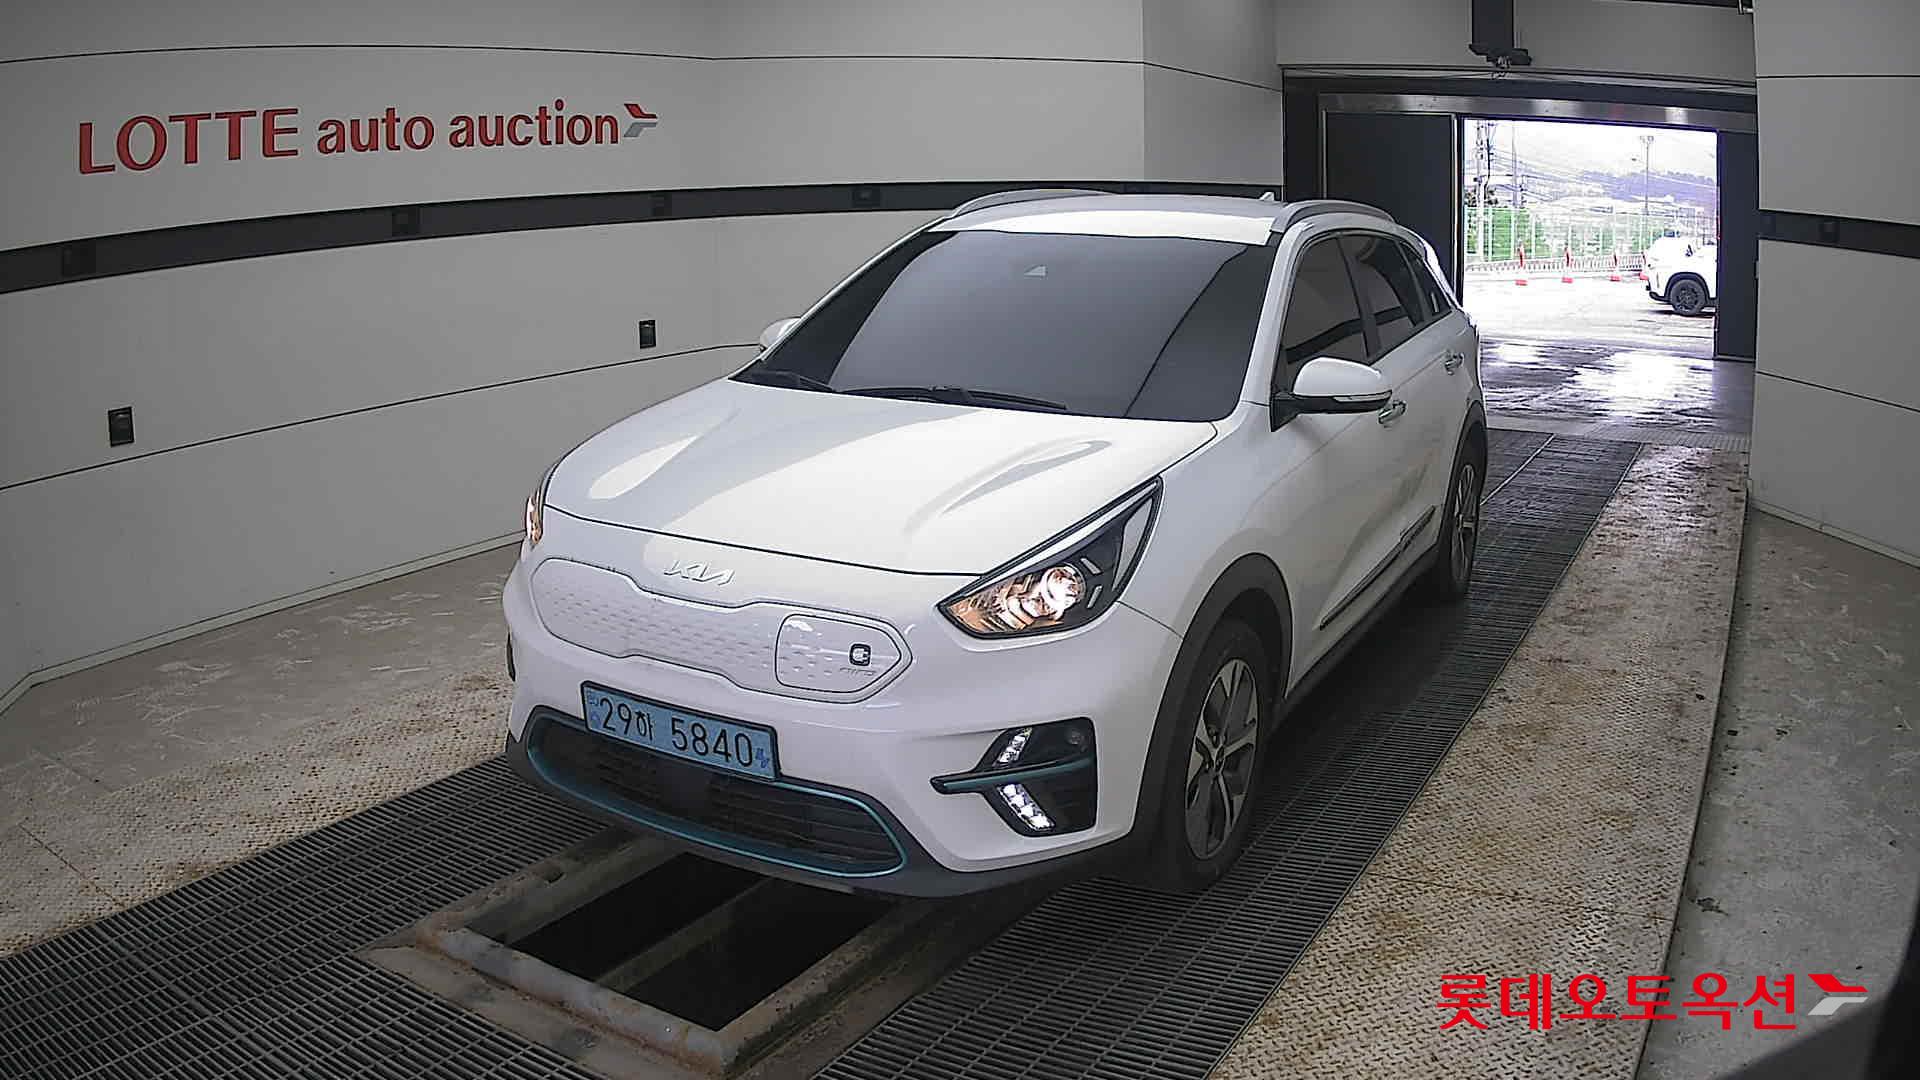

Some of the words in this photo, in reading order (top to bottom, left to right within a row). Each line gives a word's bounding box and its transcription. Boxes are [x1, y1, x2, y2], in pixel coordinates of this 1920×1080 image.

[79, 108, 298, 174] LOTTE
[316, 107, 434, 154] auto
[448, 98, 619, 149] auction
[600, 697, 654, 741] 29하
[671, 717, 752, 767] 5840
